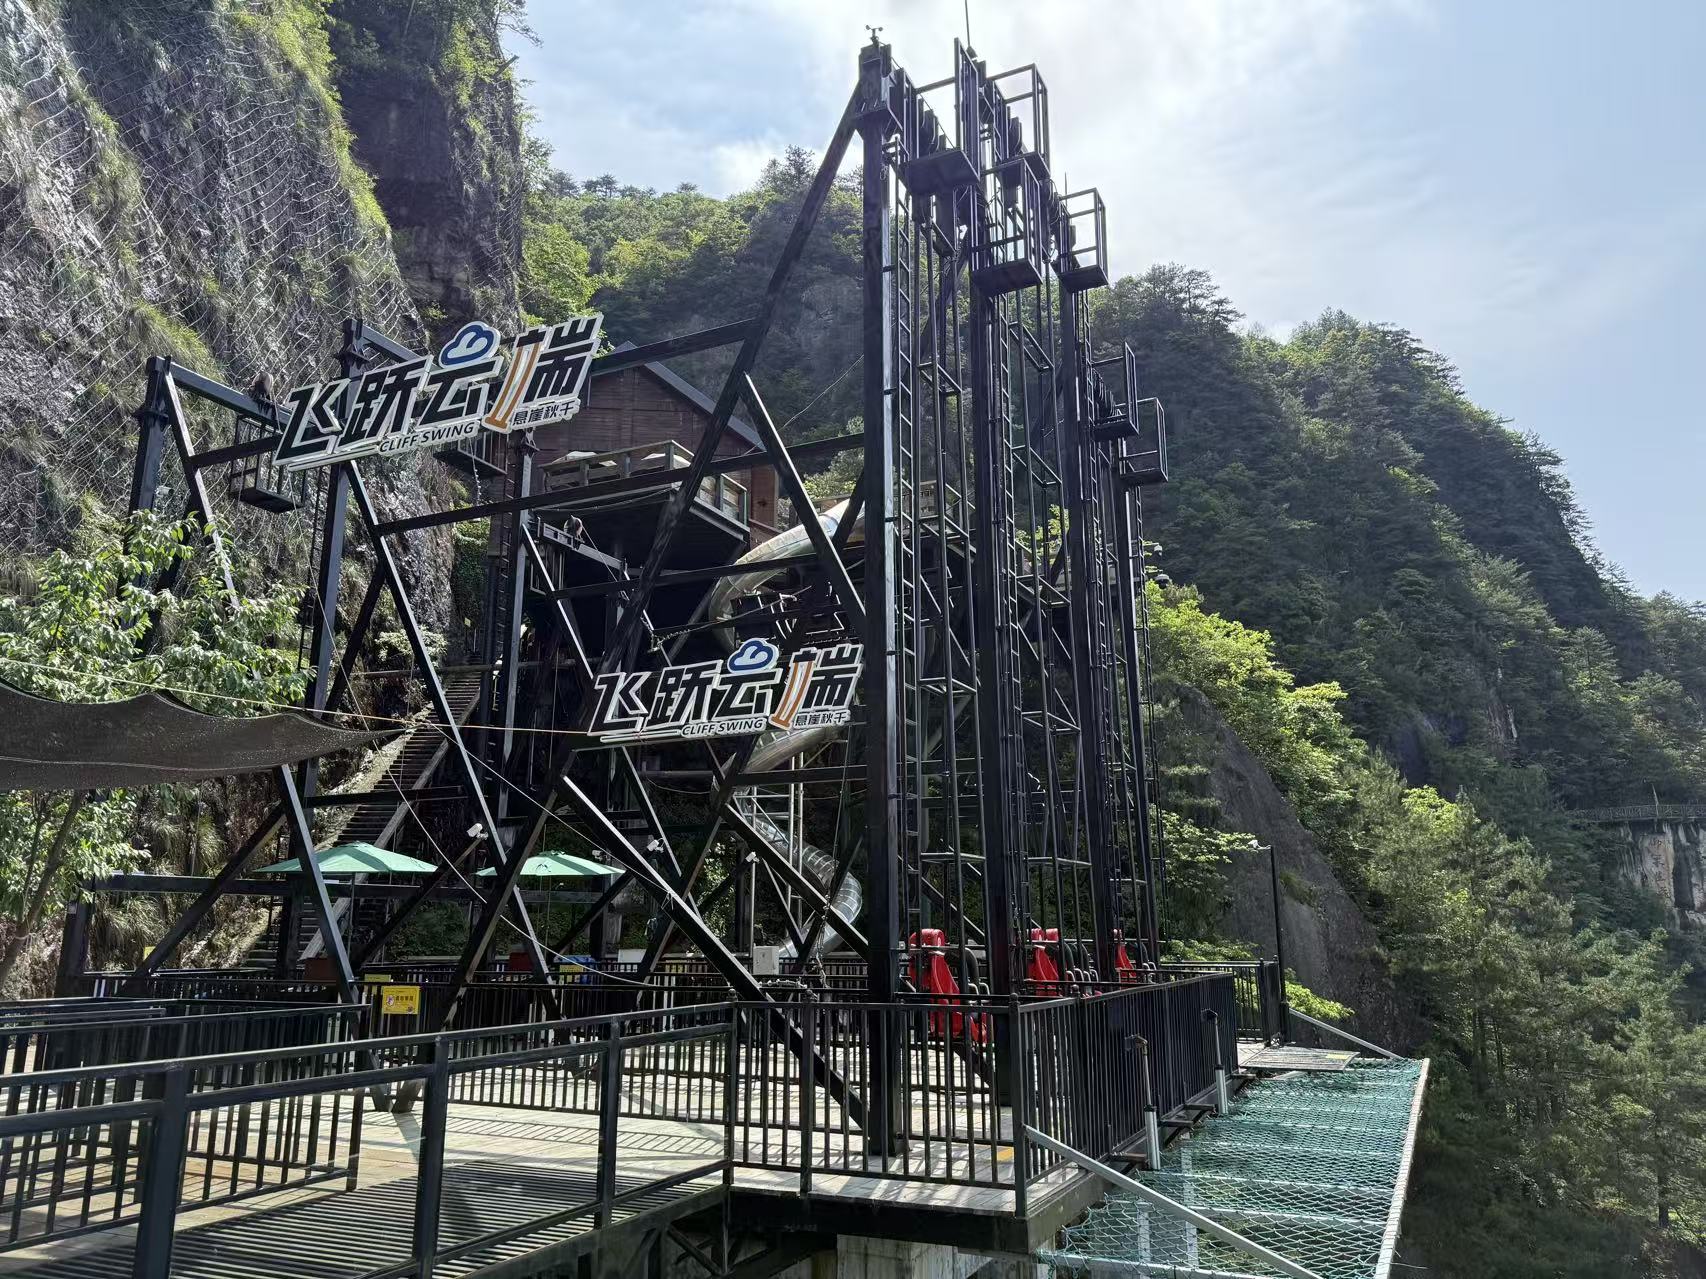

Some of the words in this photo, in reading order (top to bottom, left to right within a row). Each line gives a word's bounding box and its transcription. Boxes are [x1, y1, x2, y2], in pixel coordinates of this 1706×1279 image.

[274, 314, 602, 465] 飞跃云端
[512, 401, 575, 426] 悬崖秋千
[379, 434, 418, 454] CLIFF
[422, 423, 475, 443] SWING
[589, 644, 863, 736] 飞跃云端
[681, 723, 716, 736] CLIFF
[718, 718, 764, 732] SWING
[794, 712, 847, 727] 悬崖秋千
